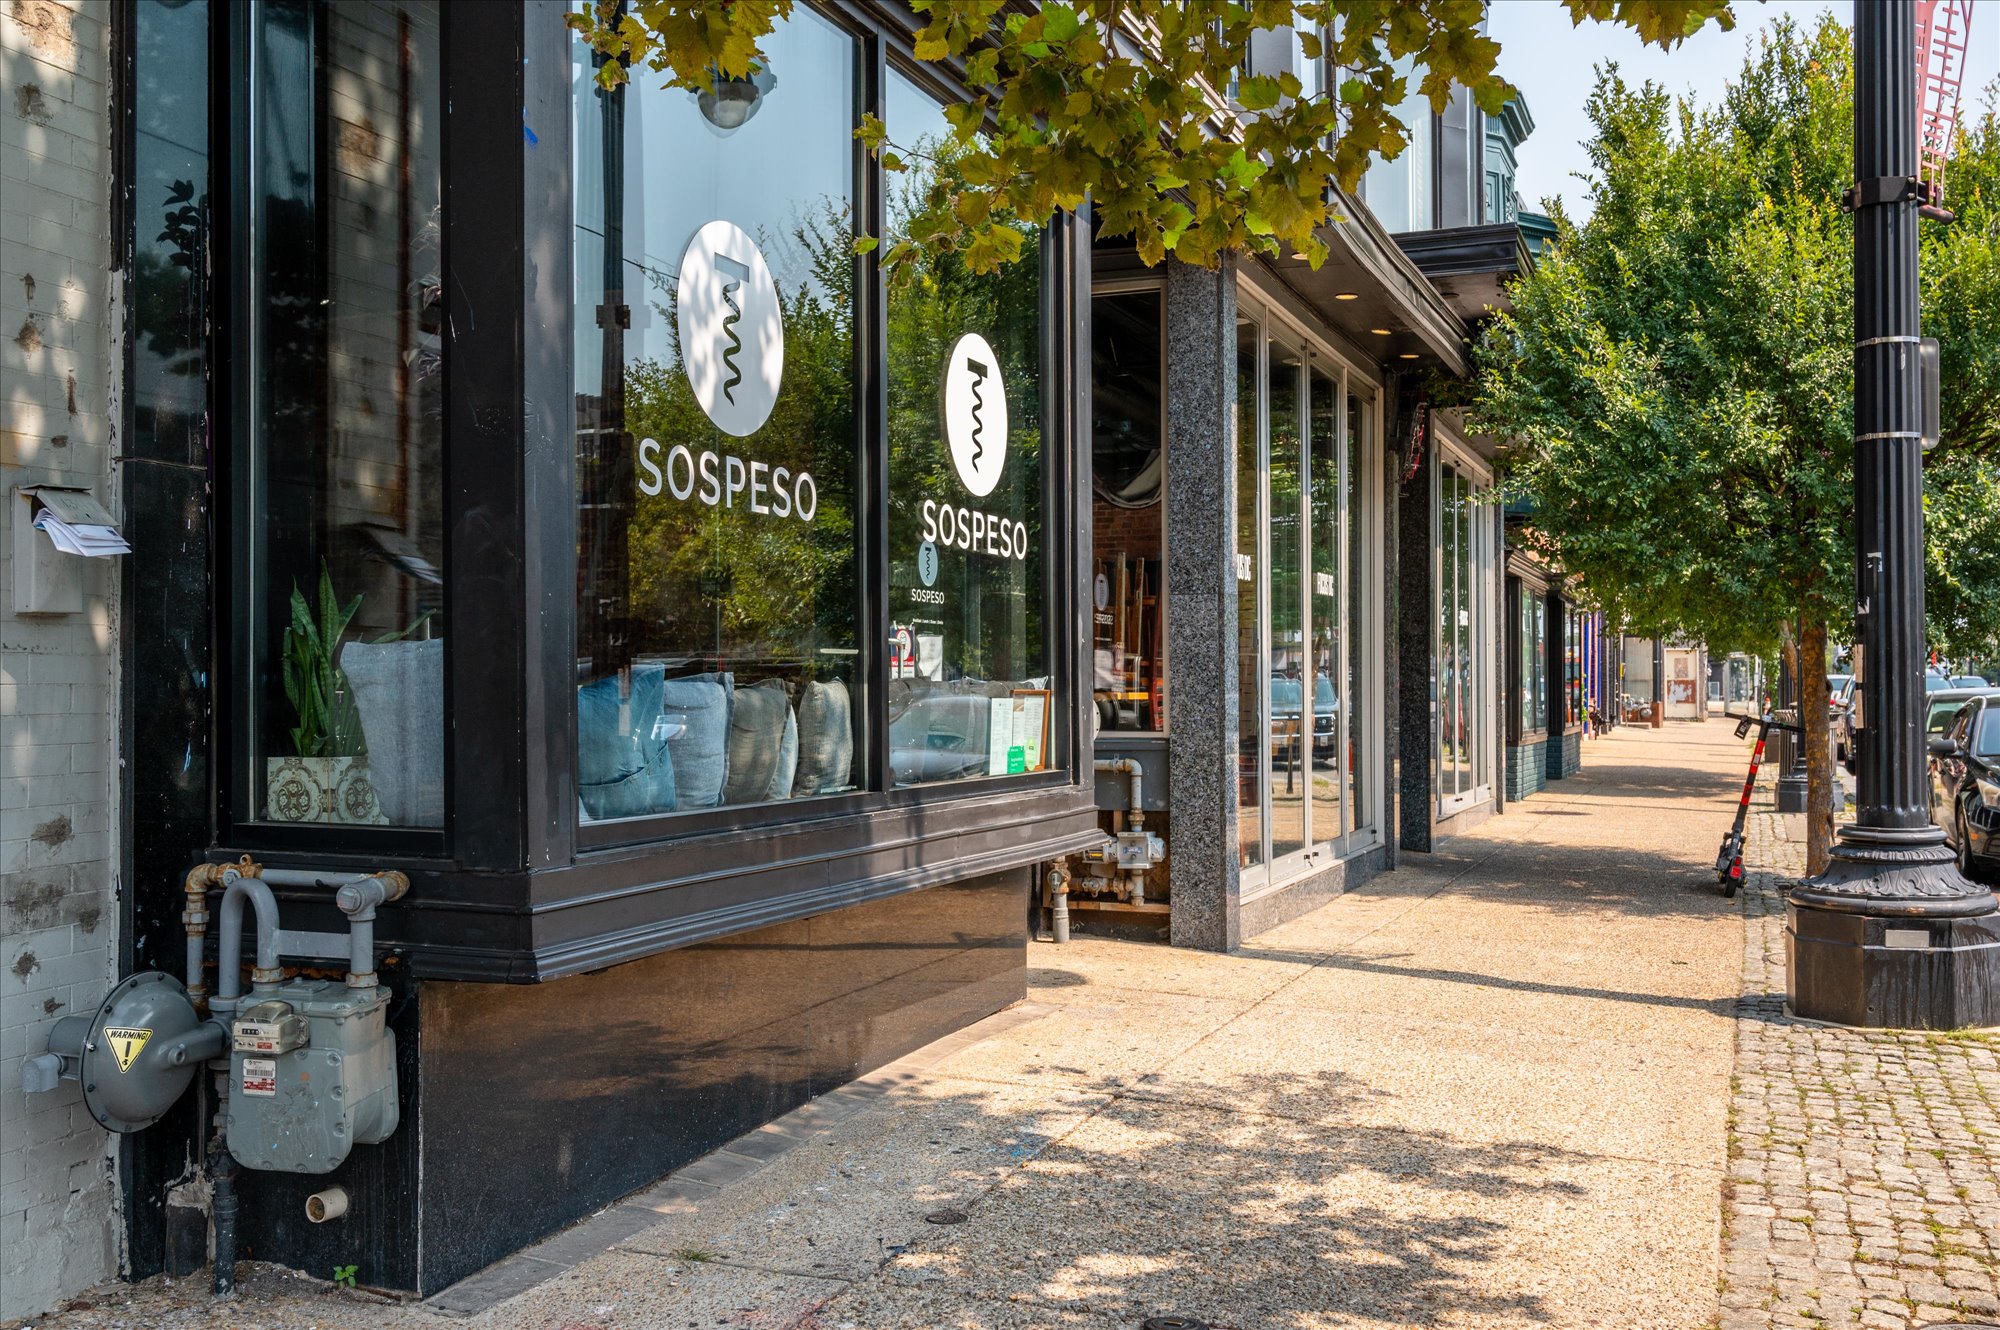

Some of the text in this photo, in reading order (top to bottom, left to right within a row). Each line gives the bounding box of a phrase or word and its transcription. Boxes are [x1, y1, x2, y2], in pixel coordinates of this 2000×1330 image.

[638, 438, 817, 521] SOSPESO
[922, 499, 1027, 560] SOSPESO
[911, 588, 945, 604] SOSPESO
